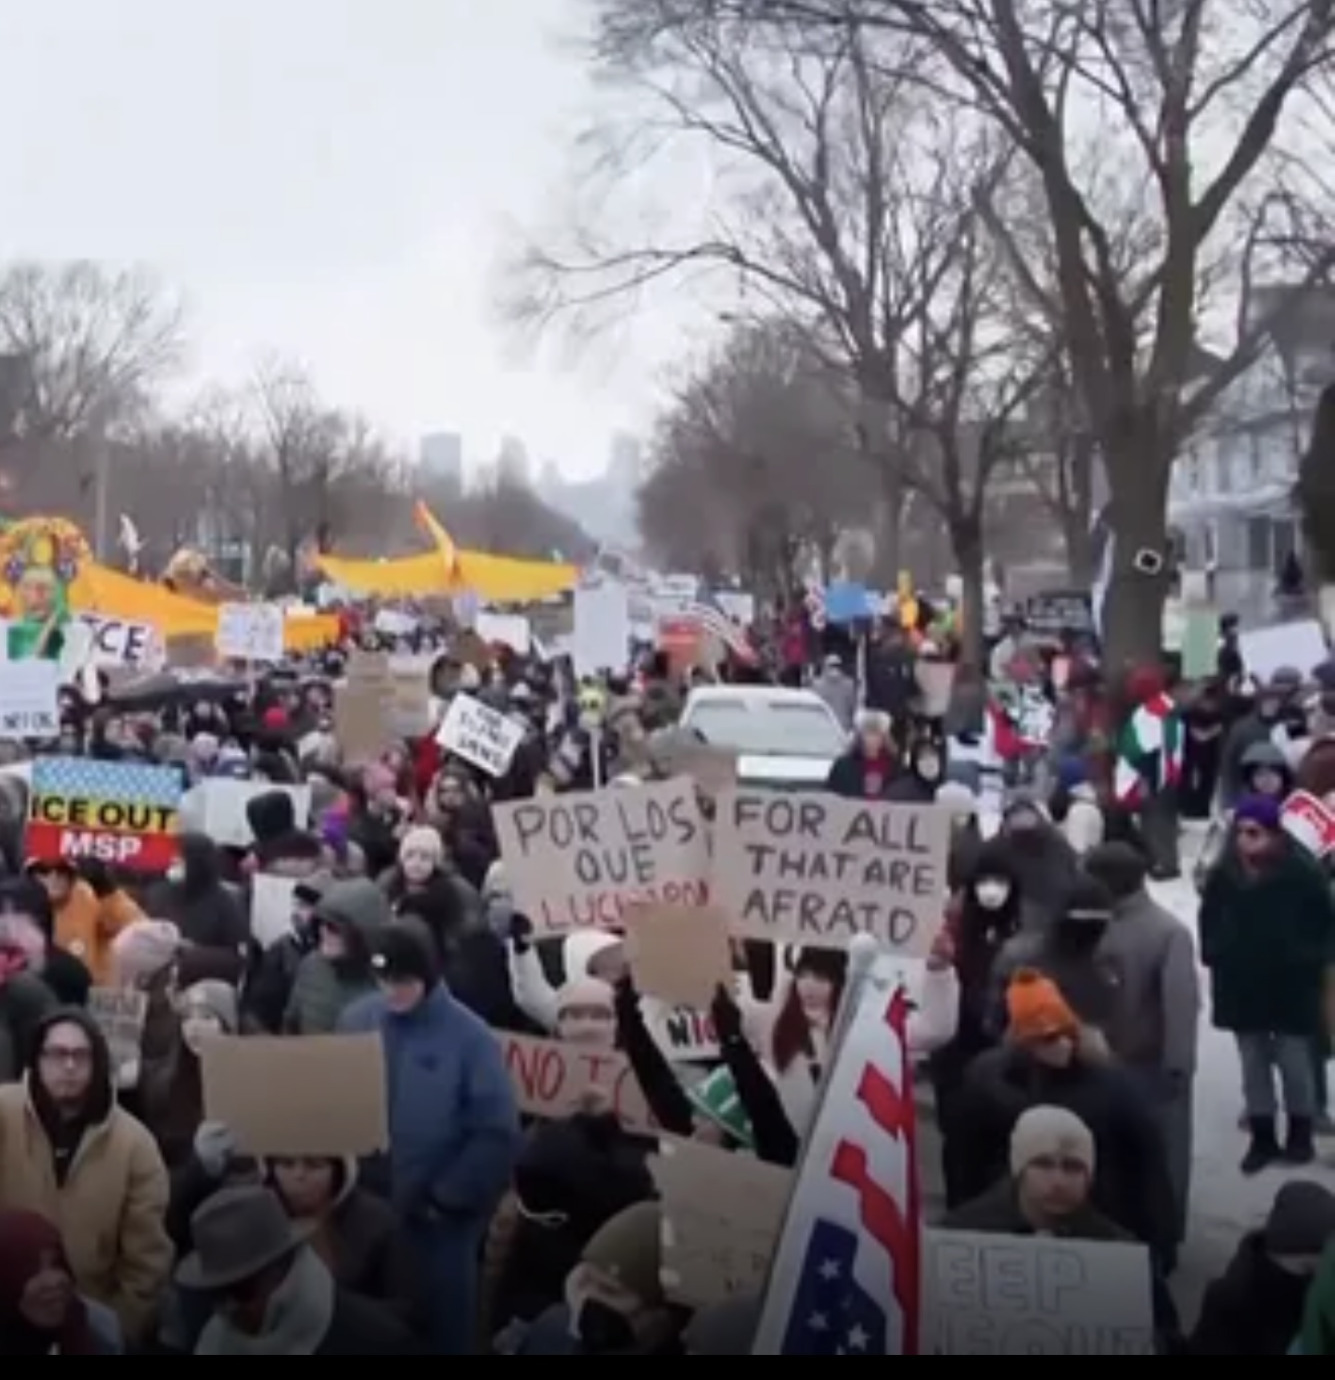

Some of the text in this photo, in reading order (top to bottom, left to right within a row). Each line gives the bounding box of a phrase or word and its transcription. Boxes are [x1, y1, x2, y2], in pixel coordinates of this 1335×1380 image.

[31, 795, 179, 831] ICE OUT
[513, 796, 697, 856] POR LOS
[733, 796, 930, 854] FOR ALL
[60, 829, 143, 862] MSP
[575, 844, 655, 884] QUE
[745, 843, 936, 896] THAT ARE
[505, 1039, 566, 1101] NO
[928, 1240, 1089, 1316] EEP
